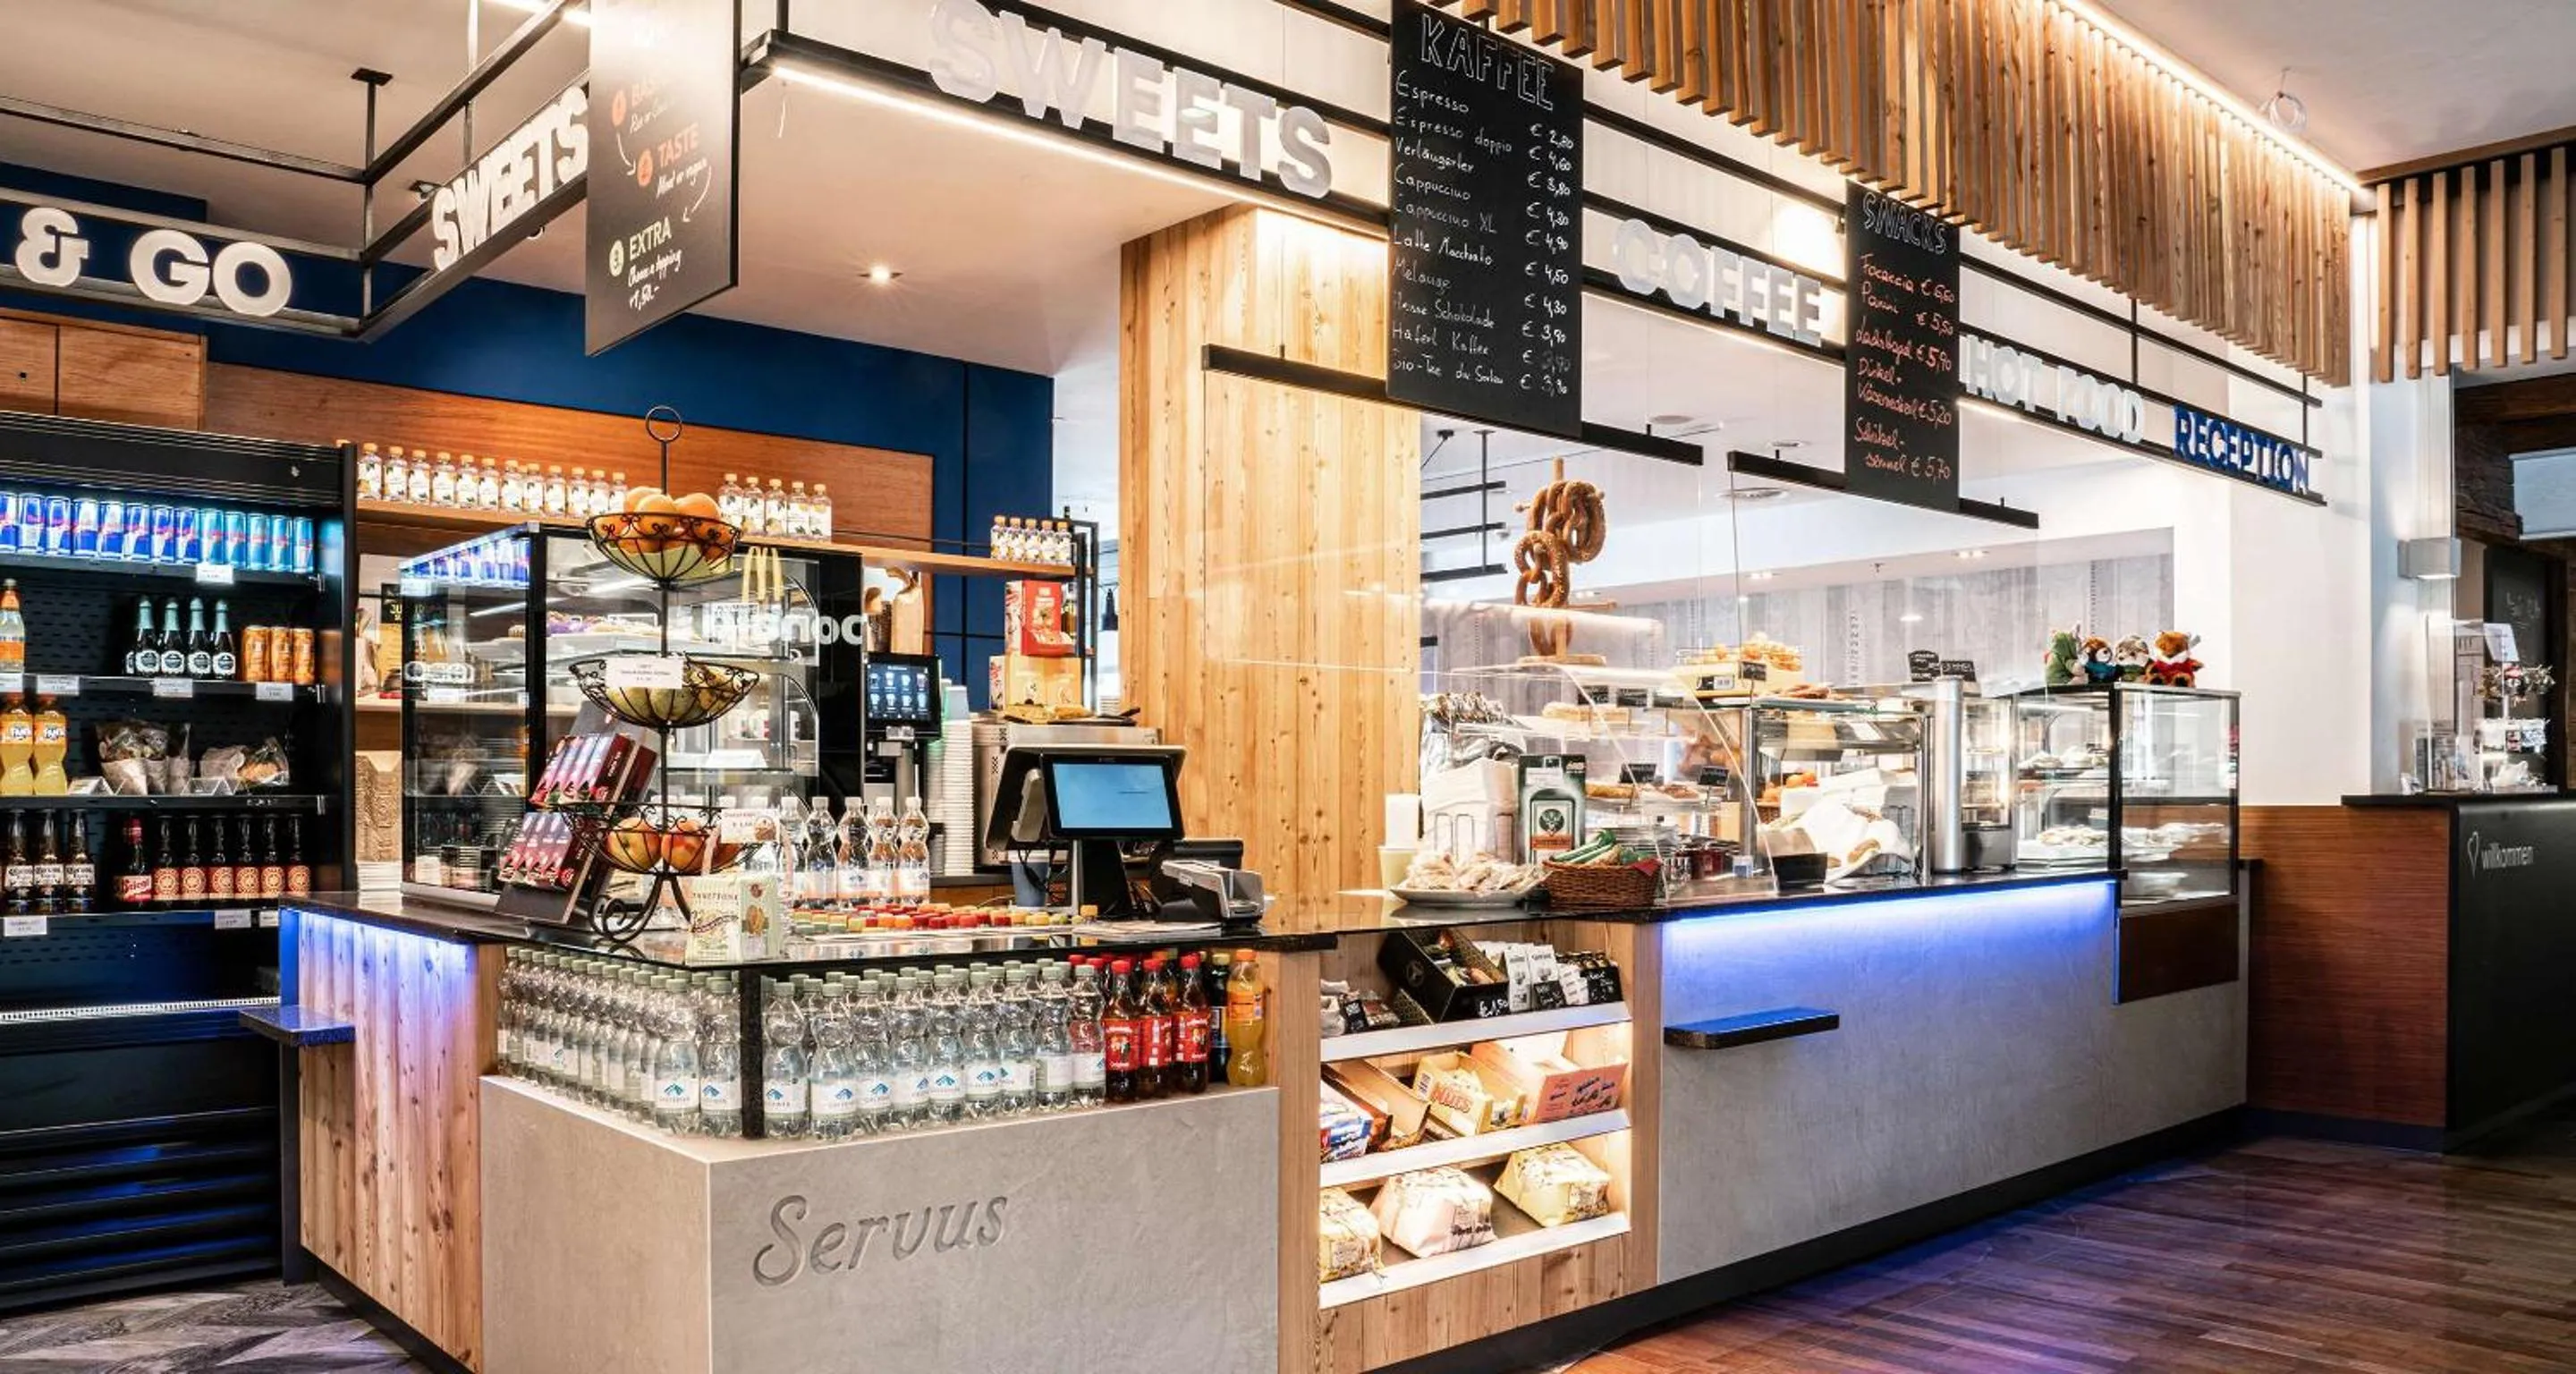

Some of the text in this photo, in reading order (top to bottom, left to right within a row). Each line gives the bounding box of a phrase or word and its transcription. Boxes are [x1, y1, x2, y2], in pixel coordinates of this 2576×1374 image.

[1395, 70, 1470, 113] Espresso
[1419, 13, 1555, 112] KAFFEE
[928, 0, 1333, 199] SWEETS
[1394, 106, 1464, 139] Espresso
[1475, 126, 1513, 154] doppio
[657, 123, 701, 168] TASTE
[432, 85, 589, 273] SWEETS
[1394, 163, 1471, 201] Cappuccino
[629, 216, 673, 261] EXTRA
[1479, 211, 1497, 234] XL
[1862, 191, 1947, 256] SNACKS
[15, 208, 292, 318] & GO
[1612, 217, 1823, 348] COFFEE
[1452, 330, 1489, 355] Kaffee
[1960, 334, 2146, 445] HOT FOOD
[2172, 403, 2310, 495] RECEPTION
[2481, 842, 2534, 870] willkommen
[753, 1195, 1007, 1286] Servus
